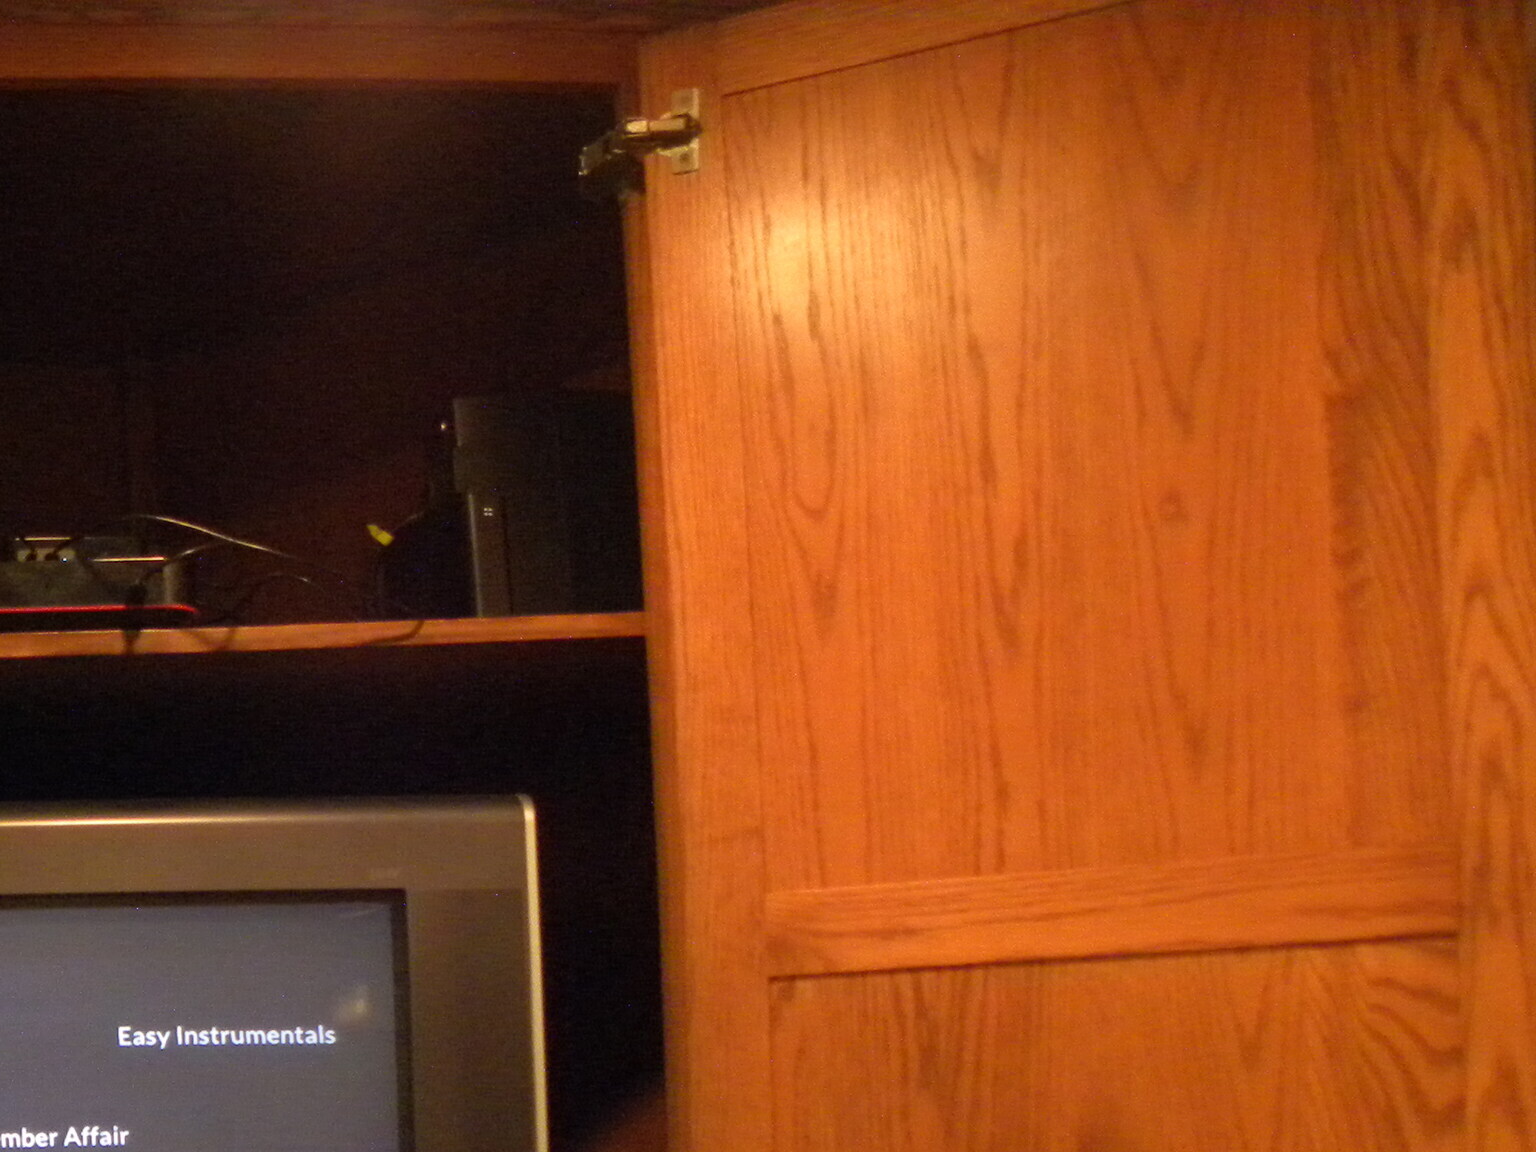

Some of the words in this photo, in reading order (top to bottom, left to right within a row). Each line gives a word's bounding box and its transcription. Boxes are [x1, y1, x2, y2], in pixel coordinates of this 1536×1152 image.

[117, 1026, 170, 1049] Easy
[176, 1025, 336, 1045] Instrumentals
[64, 1125, 129, 1147] Affair
